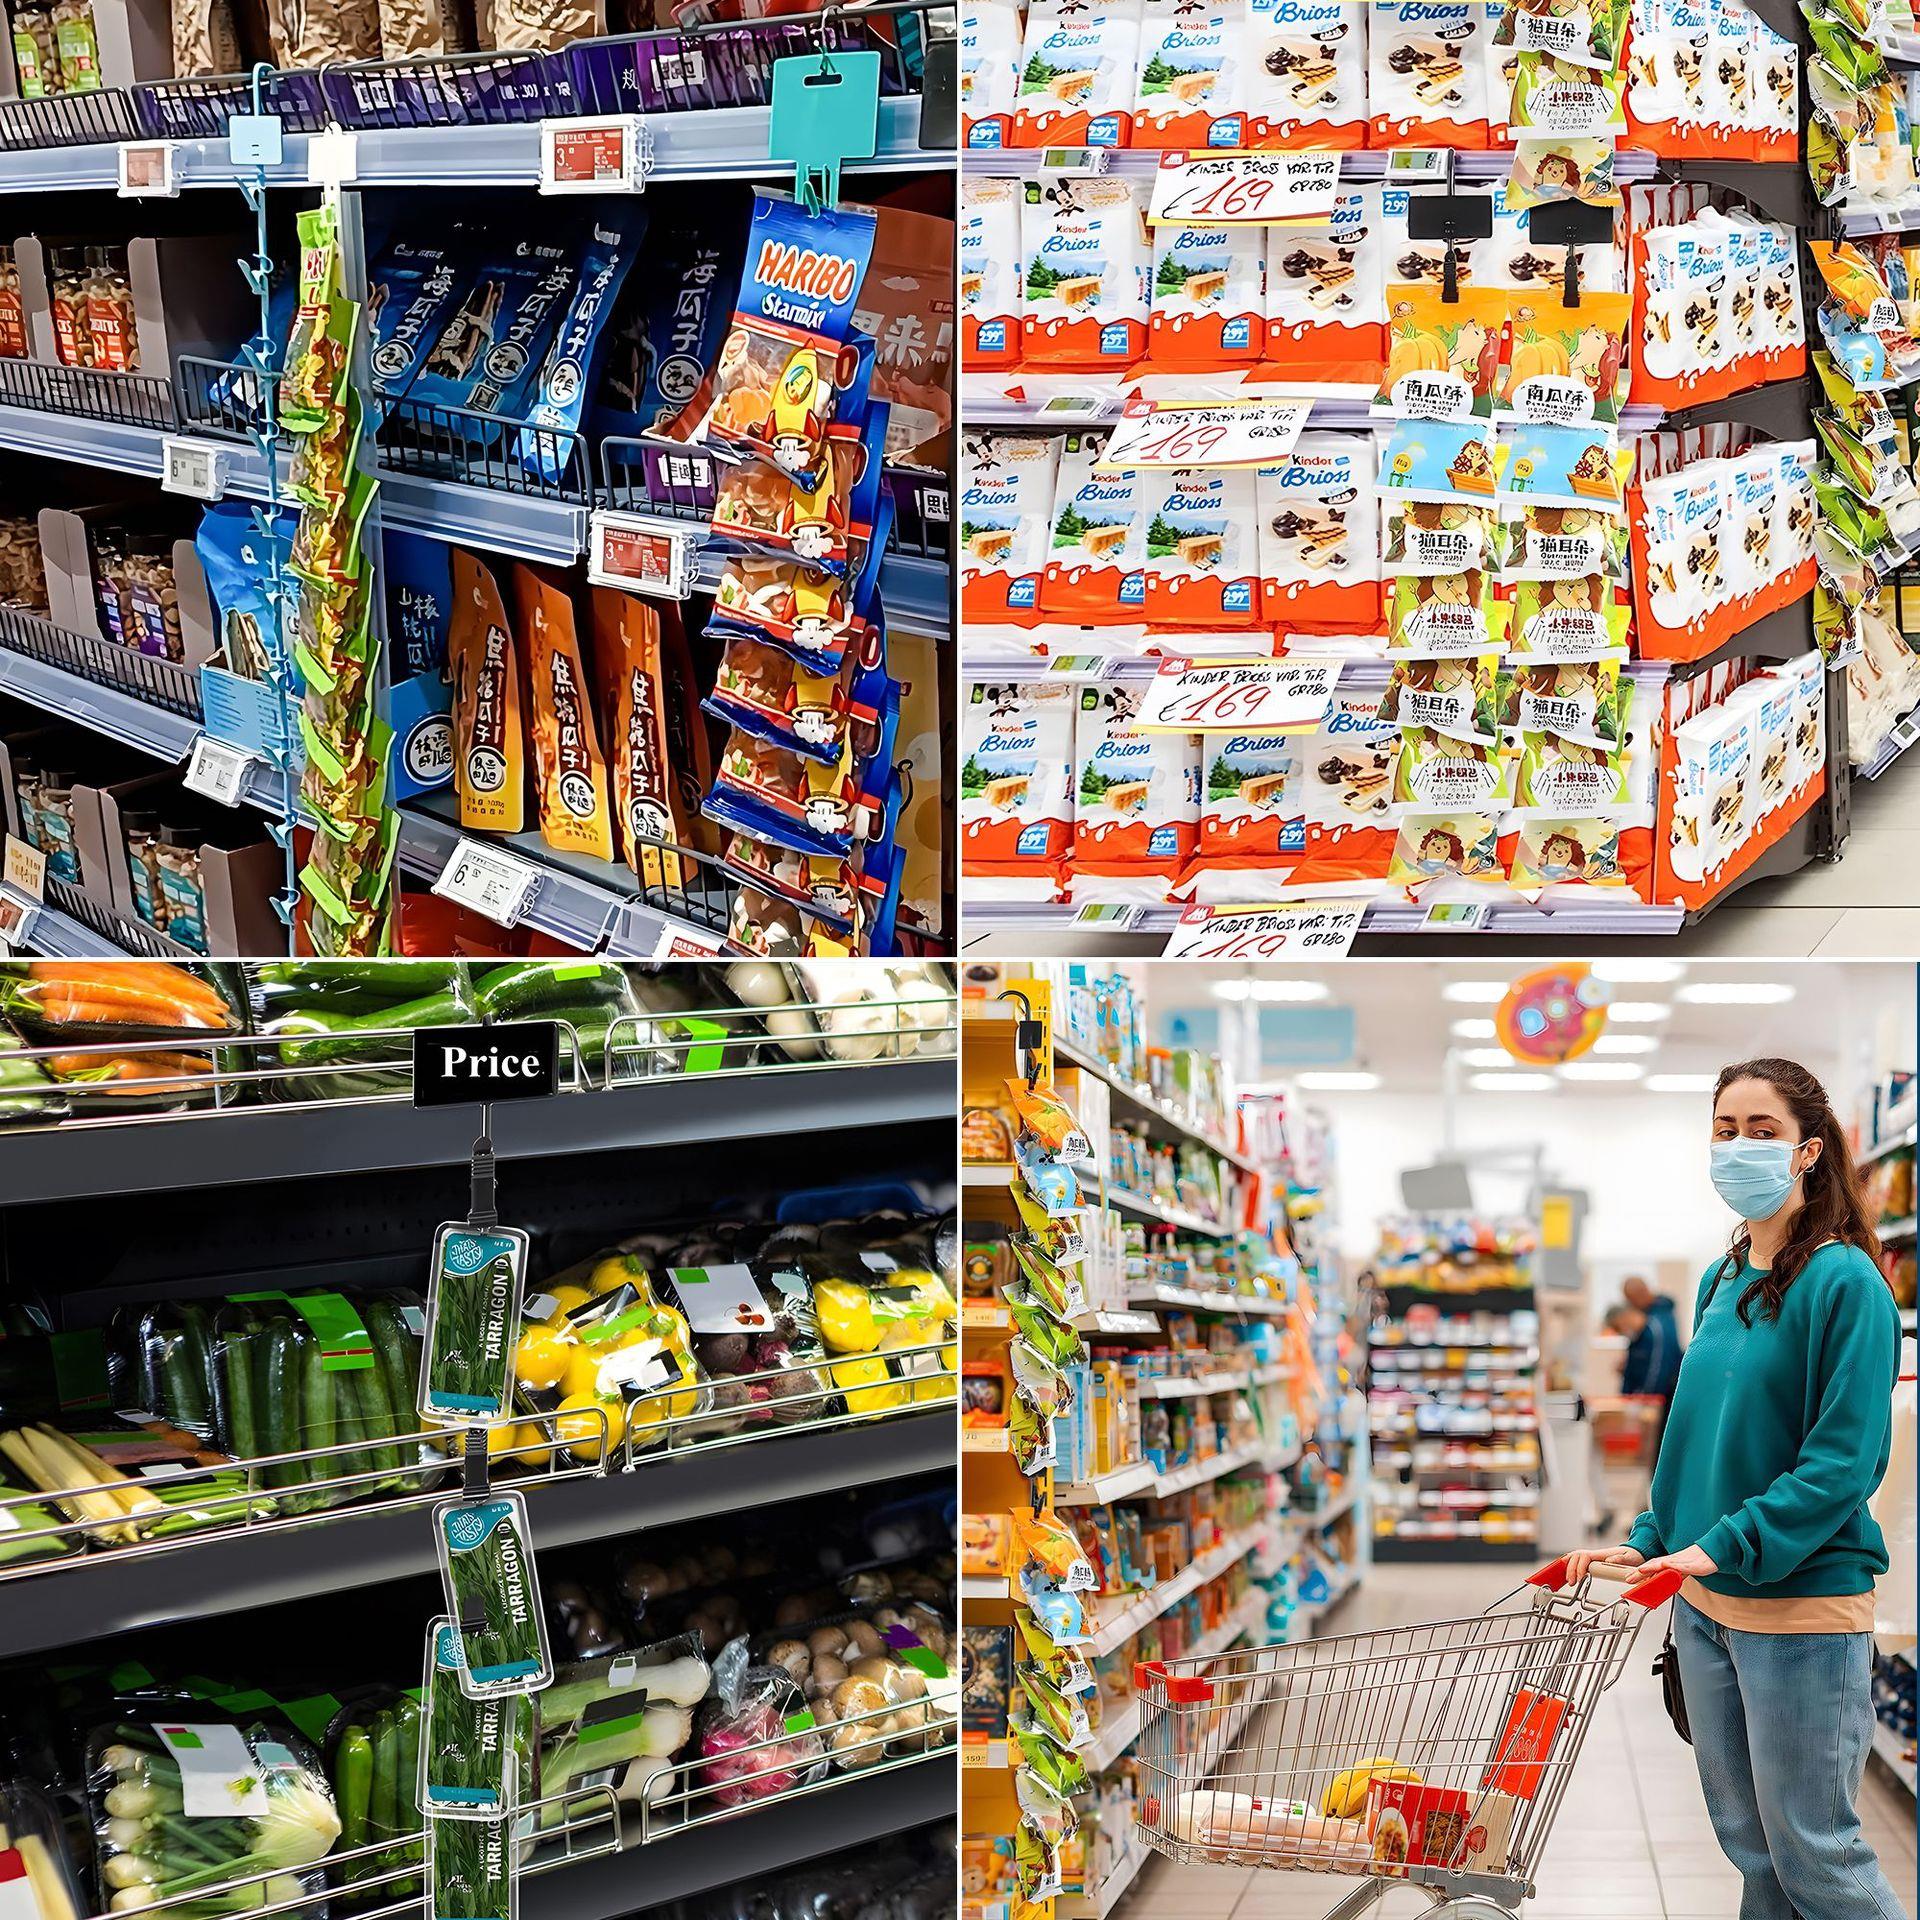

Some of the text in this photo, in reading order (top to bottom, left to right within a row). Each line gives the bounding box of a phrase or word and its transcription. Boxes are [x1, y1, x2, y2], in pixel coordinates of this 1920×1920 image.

[1274, 2, 1341, 24] Brioss
[1399, 2, 1469, 22] Brioss
[1042, 235, 1100, 253] Brioss
[1175, 231, 1228, 249] Brioss
[756, 241, 856, 304] HARIBO
[762, 292, 826, 329] Starmix
[1281, 467, 1350, 488] Brioss
[961, 488, 1017, 505] Brioss
[1075, 484, 1132, 501] Brioss
[1163, 494, 1222, 512] Brioss
[1341, 701, 1378, 712] Kinder
[978, 735, 1037, 753] Brioss
[1095, 740, 1152, 758] Brioss
[1224, 735, 1286, 755] Brioss
[441, 1045, 541, 1079] Price
[485, 1274, 509, 1360] TARRAGON
[500, 1537, 528, 1628] TARRAGON
